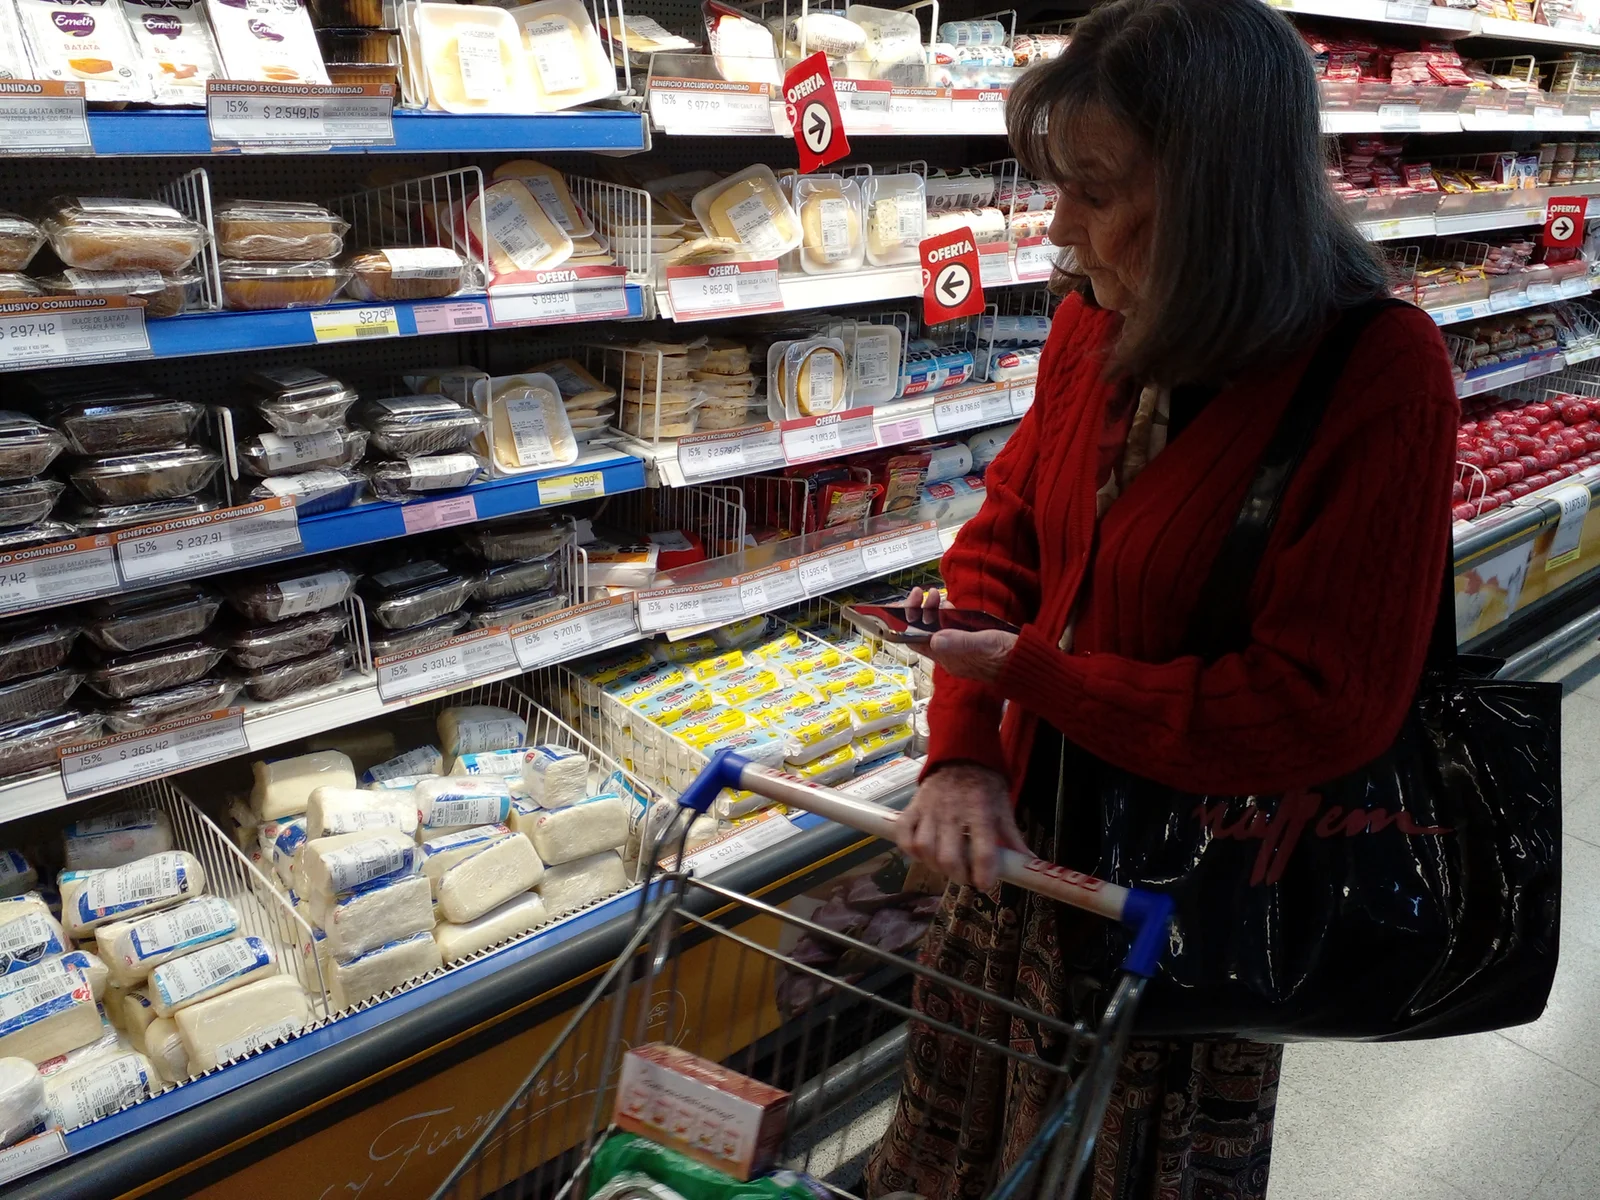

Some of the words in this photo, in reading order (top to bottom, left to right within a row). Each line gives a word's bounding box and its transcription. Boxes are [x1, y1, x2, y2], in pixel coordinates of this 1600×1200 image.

[55, 14, 94, 26] Emeth
[146, 18, 181, 30] Emeth
[210, 84, 257, 92] BENEFICIO
[260, 84, 308, 94] EXCLUSIVO
[651, 80, 682, 88] BENEFICIO
[683, 81, 714, 89] EXCLUSIVO
[715, 82, 750, 91] COMUNIDAD
[787, 73, 826, 104] OFERTA
[833, 80, 858, 92] FERTA
[661, 93, 676, 105] 15%
[978, 92, 1003, 102] OFERTA
[226, 101, 248, 113] 15%
[264, 106, 270, 119] $
[1550, 204, 1581, 214] OFERTA
[928, 240, 974, 264] OFERTA
[536, 270, 579, 284] OFERTA
[708, 265, 741, 277] OFERTA
[702, 285, 708, 295] $
[42, 299, 106, 309] COMUNIDAD
[532, 294, 538, 305] $
[93, 315, 101, 323] DE
[104, 314, 130, 322] BATATA
[10, 323, 56, 338] 297,42
[815, 414, 842, 427] OFERTA
[707, 432, 736, 440] EXCLUSIVO
[688, 446, 701, 457] 15%
[117, 525, 162, 540] BENEFICIO
[164, 515, 212, 530] EXCLUSIVO
[214, 504, 265, 522] COMUNIDAD
[15, 543, 76, 560] COMUNIDAD
[134, 540, 157, 555] 15%
[177, 540, 183, 551] $
[867, 547, 878, 556] 15%
[638, 590, 664, 599] BENEFICIO
[665, 586, 693, 595] EXCLUSIVO
[647, 601, 661, 612] 15%
[511, 621, 542, 635] BENEFICIO
[543, 610, 573, 625] EXCLUSIVO
[574, 599, 611, 614] COMUNIDAD
[524, 632, 540, 646] 15%
[378, 651, 414, 665] BENEFICIO
[414, 640, 449, 656] EXCLUSIVO
[448, 630, 489, 645] COMUNIDAD
[390, 664, 408, 677] 15%
[421, 662, 429, 673] $
[634, 674, 671, 695] Cremón
[727, 672, 759, 690] Cremón
[661, 692, 697, 712] Cremón
[761, 692, 796, 709] Cremón
[686, 711, 724, 728] Cremón
[801, 709, 834, 728] Cremón
[62, 740, 108, 755] BENEFICIO
[110, 727, 158, 743] EXCLUSIVO
[159, 713, 212, 731] COMUNIDAD
[79, 753, 102, 766] 15%
[119, 751, 127, 761] $
[691, 836, 723, 853] EXCLUSIVO
[724, 819, 758, 838] COMUNIDAD
